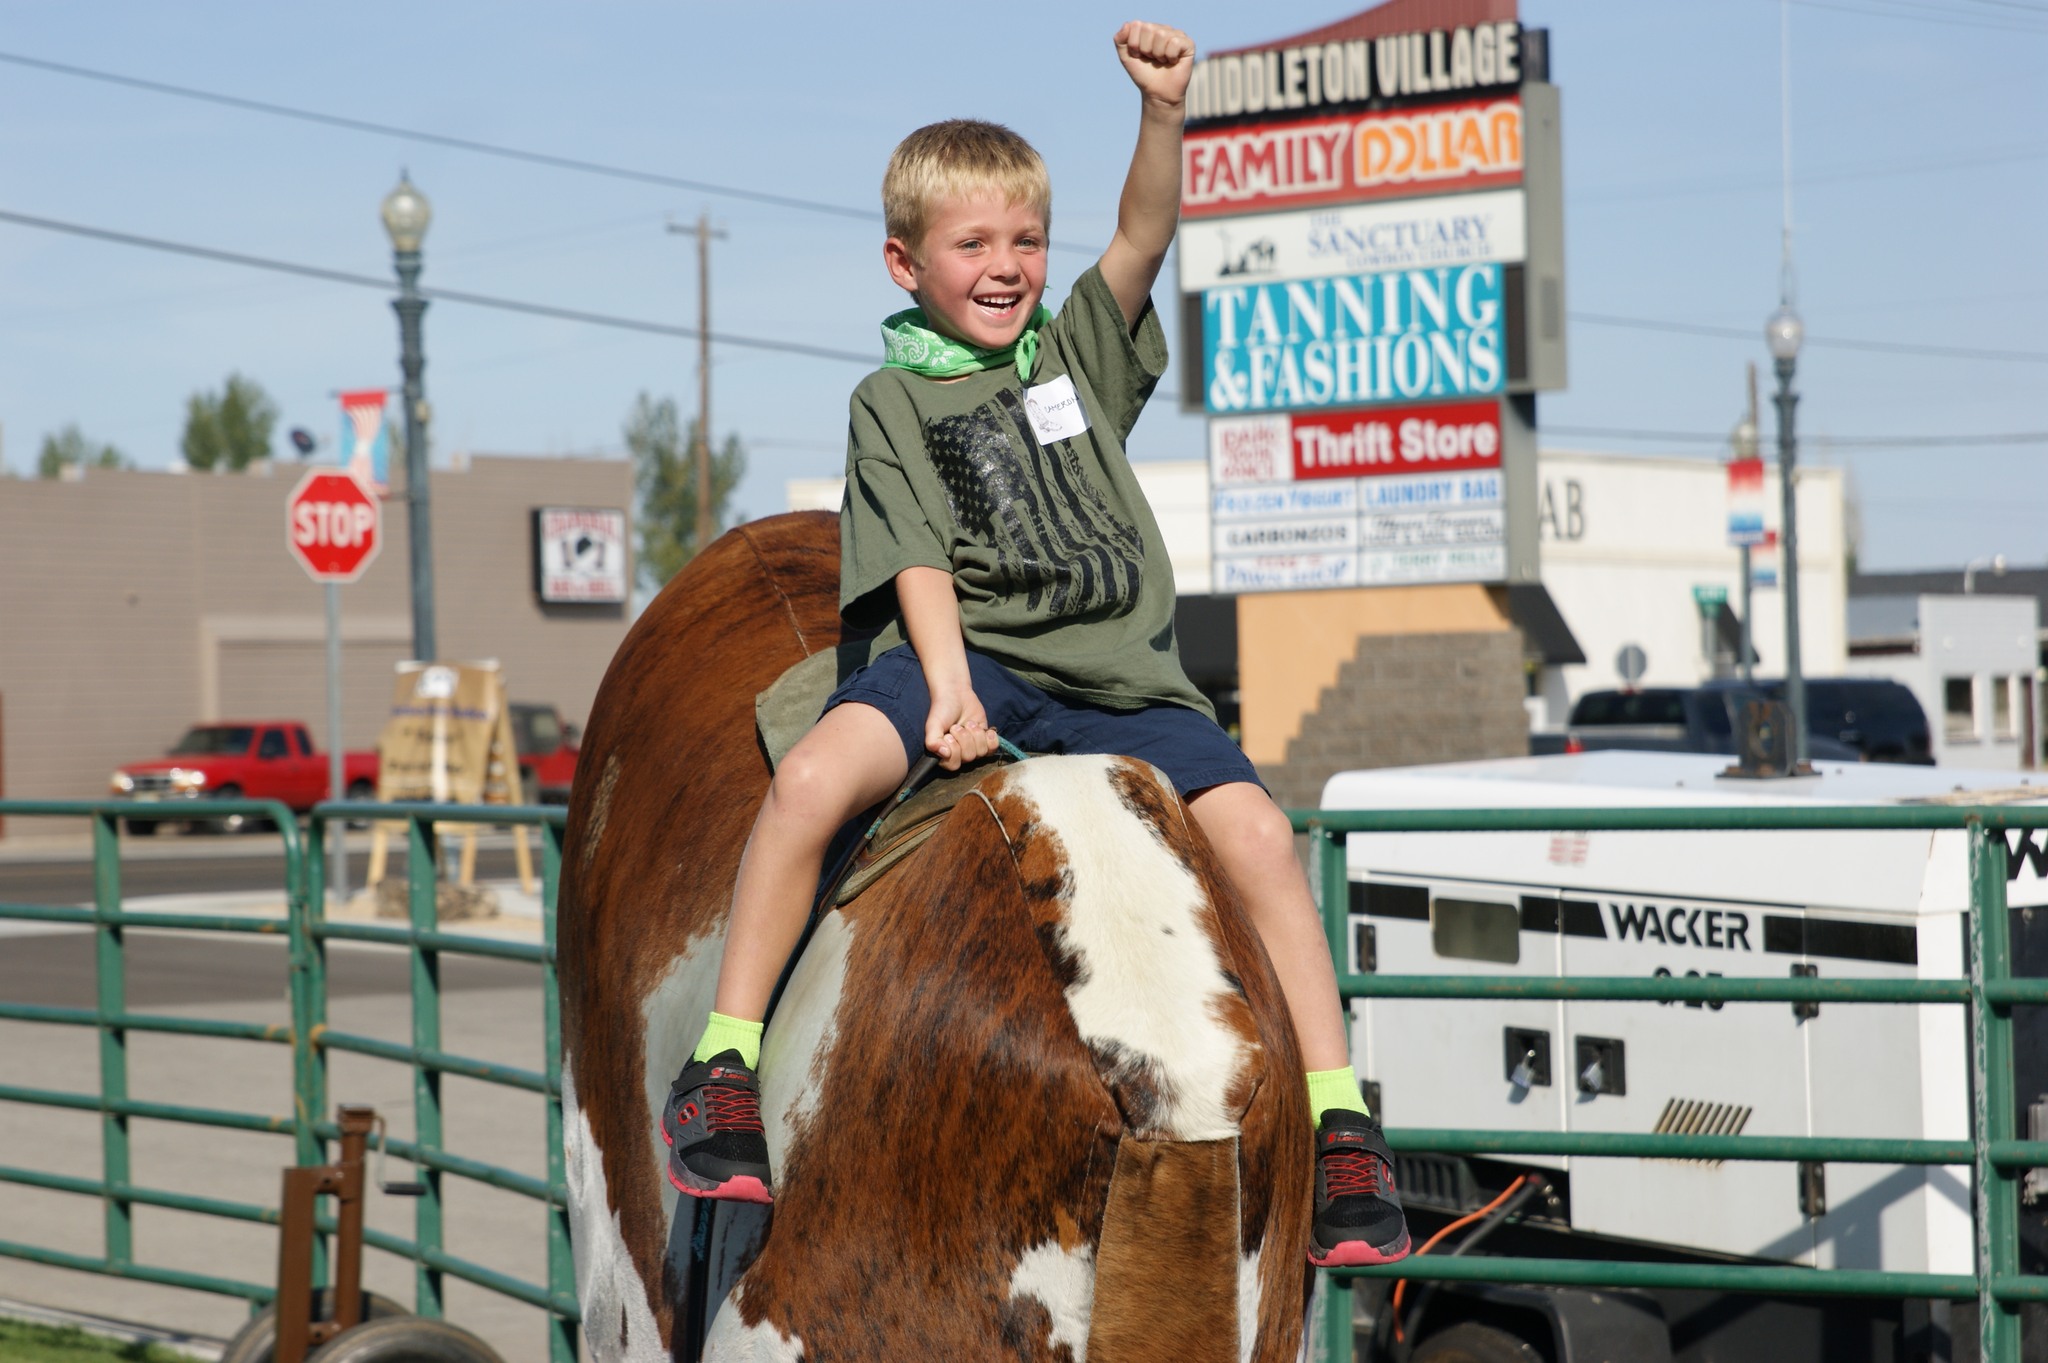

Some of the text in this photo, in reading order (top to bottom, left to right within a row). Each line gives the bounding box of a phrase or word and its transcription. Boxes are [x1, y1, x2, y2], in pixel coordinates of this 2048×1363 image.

[1185, 21, 1521, 118] MIDDLETON VILLAGE
[1186, 104, 1521, 201] FAMILY DOLLAR
[1308, 213, 1489, 256] SANCTUARY
[1207, 265, 1499, 348] TANNING
[1210, 327, 1501, 410] &FASHIONS
[1294, 417, 1498, 469] Thrift Store
[1366, 477, 1498, 507] LAUNDRY BAG
[294, 502, 374, 548] STOP
[1609, 903, 1752, 951] WACKER
